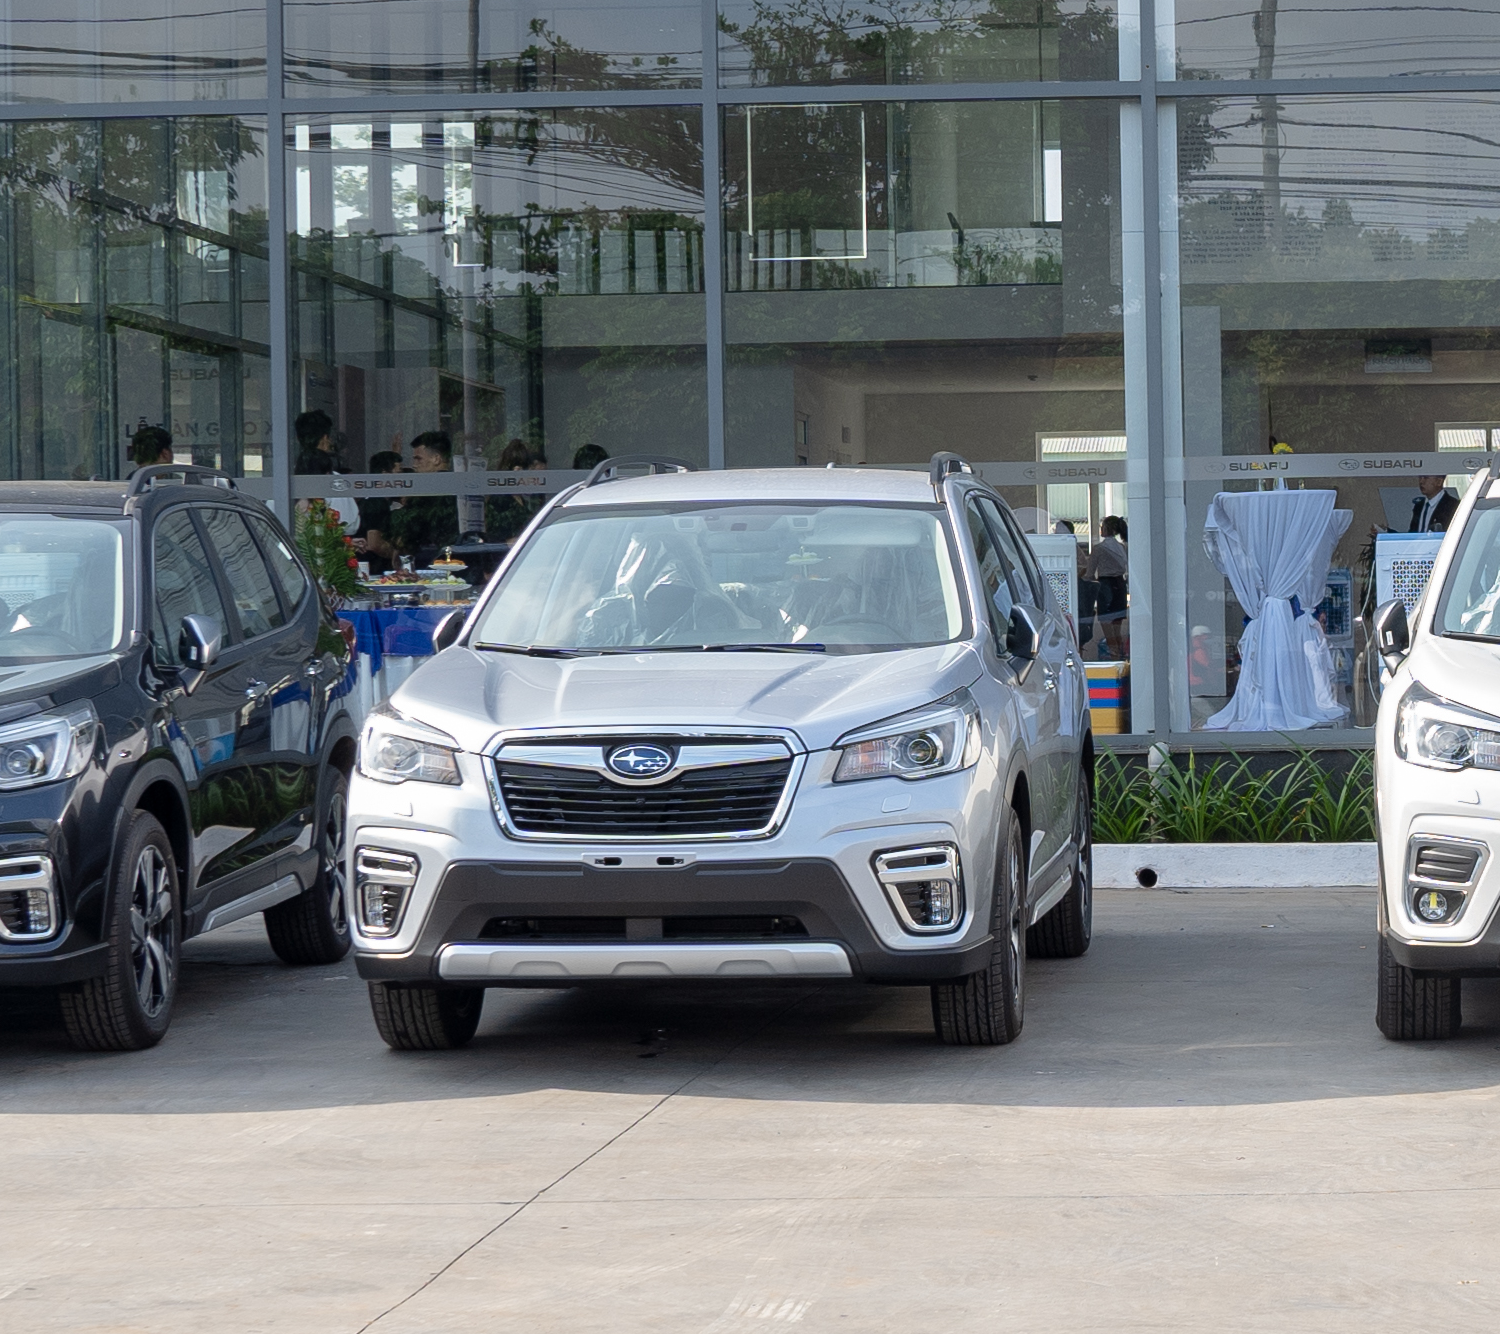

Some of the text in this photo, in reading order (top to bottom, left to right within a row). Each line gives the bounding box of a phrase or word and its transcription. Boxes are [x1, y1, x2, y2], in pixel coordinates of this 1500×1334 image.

[169, 367, 252, 381] SUBAU
[156, 418, 200, 437] ÀN
[1228, 461, 1289, 471] SUBARU
[1363, 459, 1424, 469] SUBARU
[1048, 467, 1108, 478] SUBARU
[354, 479, 414, 489] SUBARU
[487, 477, 547, 487] SUBARU
